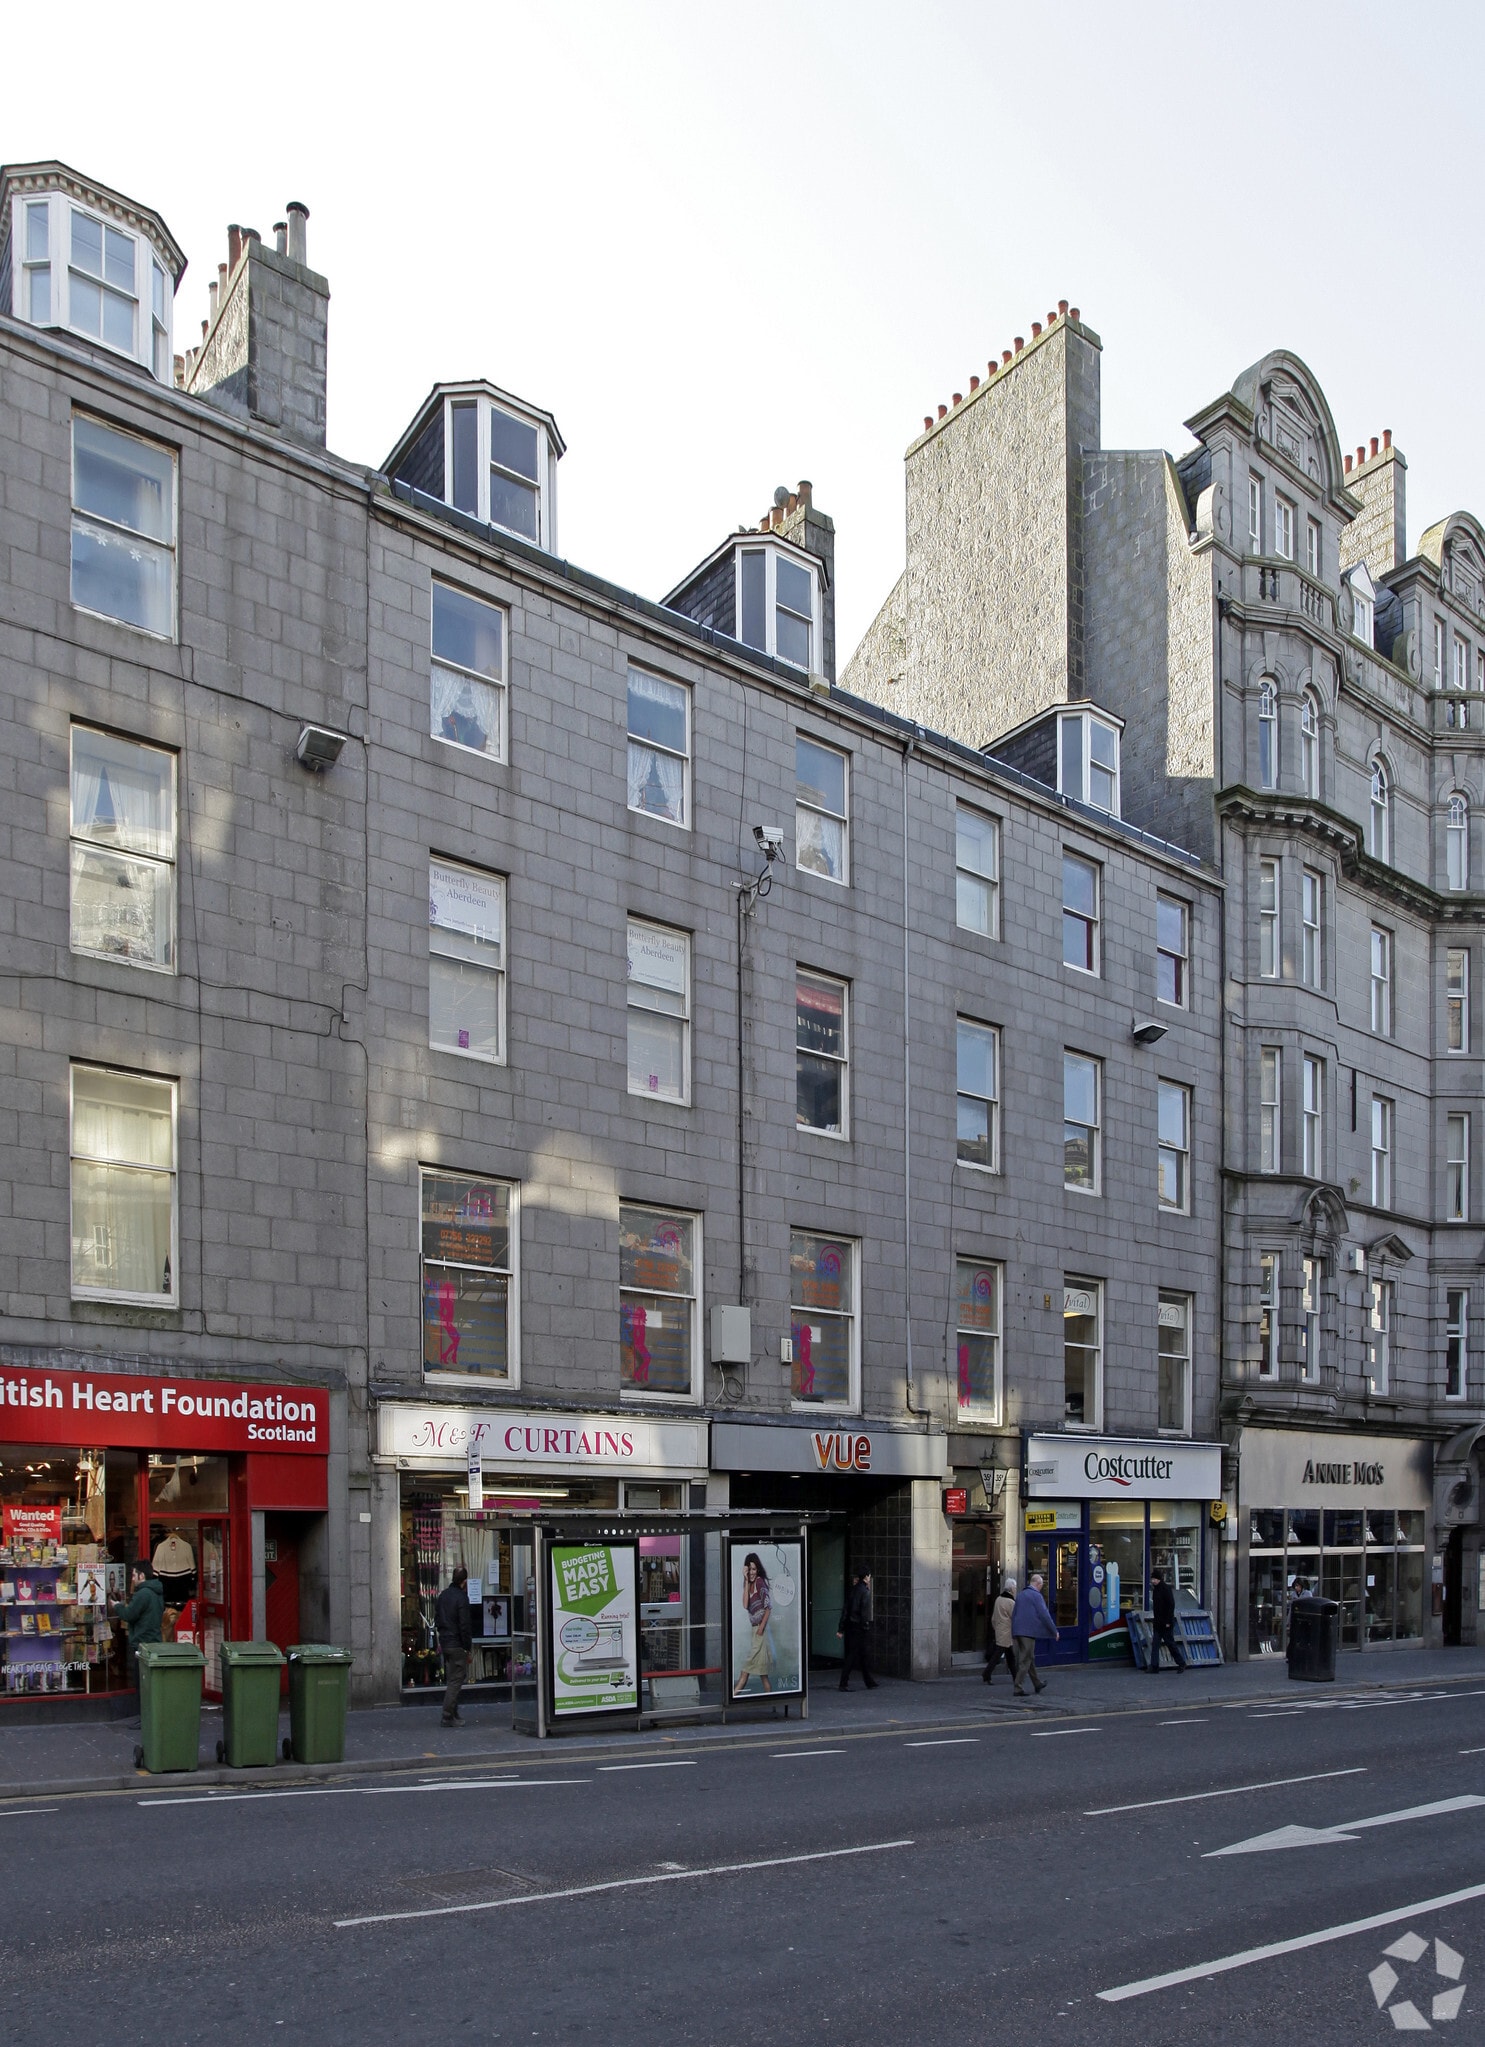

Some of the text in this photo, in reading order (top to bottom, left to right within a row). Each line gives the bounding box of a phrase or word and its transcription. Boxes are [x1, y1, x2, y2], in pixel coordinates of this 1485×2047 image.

[433, 870, 499, 901] Butterfly Beauty
[447, 888, 487, 908] Aberdeen
[629, 929, 686, 955] Butterfly Beauty
[640, 945, 675, 962] Aberdeen
[72, 1382, 154, 1413] Heart
[161, 1388, 316, 1422] Foundation
[247, 1424, 316, 1442] Scotland
[411, 1421, 449, 1448] M
[450, 1425, 467, 1446] &
[504, 1426, 634, 1457] CURTAINS
[1028, 1468, 1055, 1477] Costcutter
[1084, 1452, 1174, 1481] Costcutter
[1302, 1459, 1352, 1485] ANNIE
[10, 1509, 55, 1521] Wanted
[561, 1550, 606, 1569] BUDGETING
[562, 1559, 609, 1585] MADE
[566, 1575, 609, 1602] EASY
[1, 1661, 91, 1674] HEART DISEASE TOGETHER
[601, 1695, 617, 1703] ASDA
